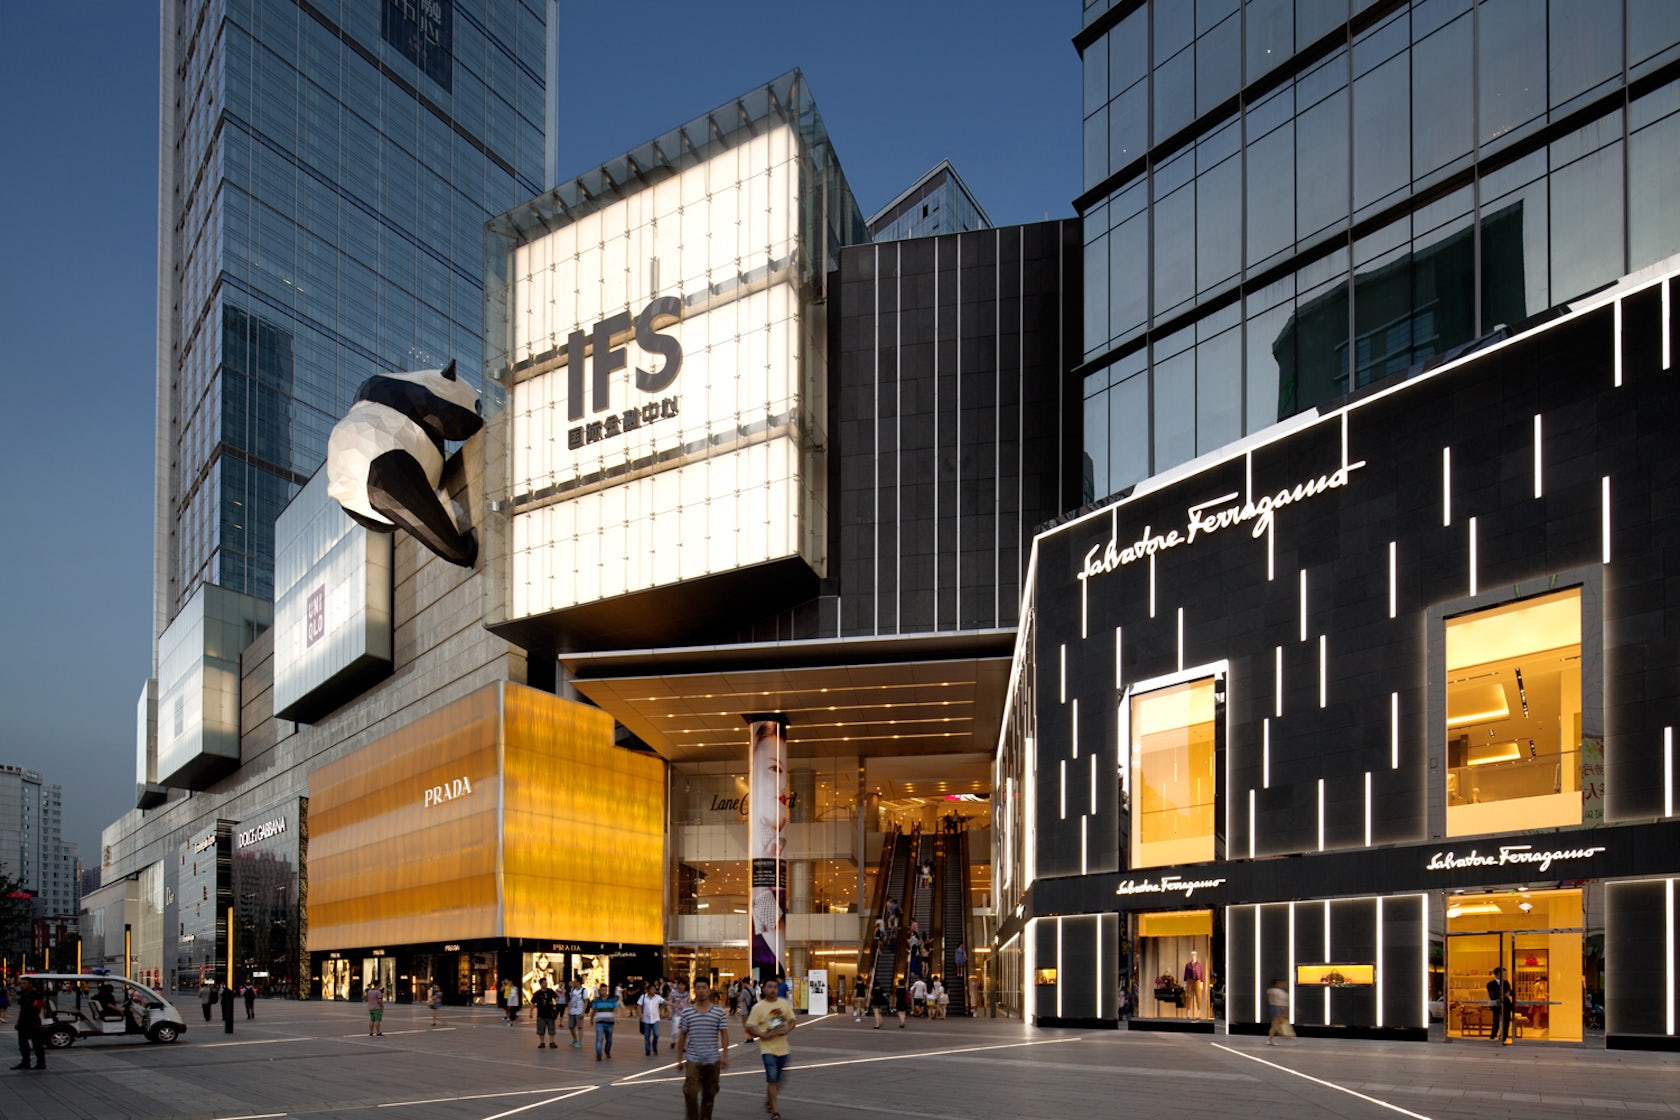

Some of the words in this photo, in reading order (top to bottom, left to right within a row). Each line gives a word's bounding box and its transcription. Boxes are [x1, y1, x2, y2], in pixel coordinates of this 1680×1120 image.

[567, 296, 684, 422] IFS
[567, 395, 680, 450] 国际金融中心
[1077, 525, 1185, 580] Salvatore
[1186, 460, 1367, 539] Ferragamo
[424, 775, 472, 809] PRADA
[710, 793, 740, 811] Lane
[1427, 850, 1498, 871] Salvatore
[1498, 845, 1606, 873] Ferragamo
[1116, 879, 1161, 895] Salvatore
[1160, 876, 1227, 898] Ferragamo
[552, 943, 582, 952] PRADA
